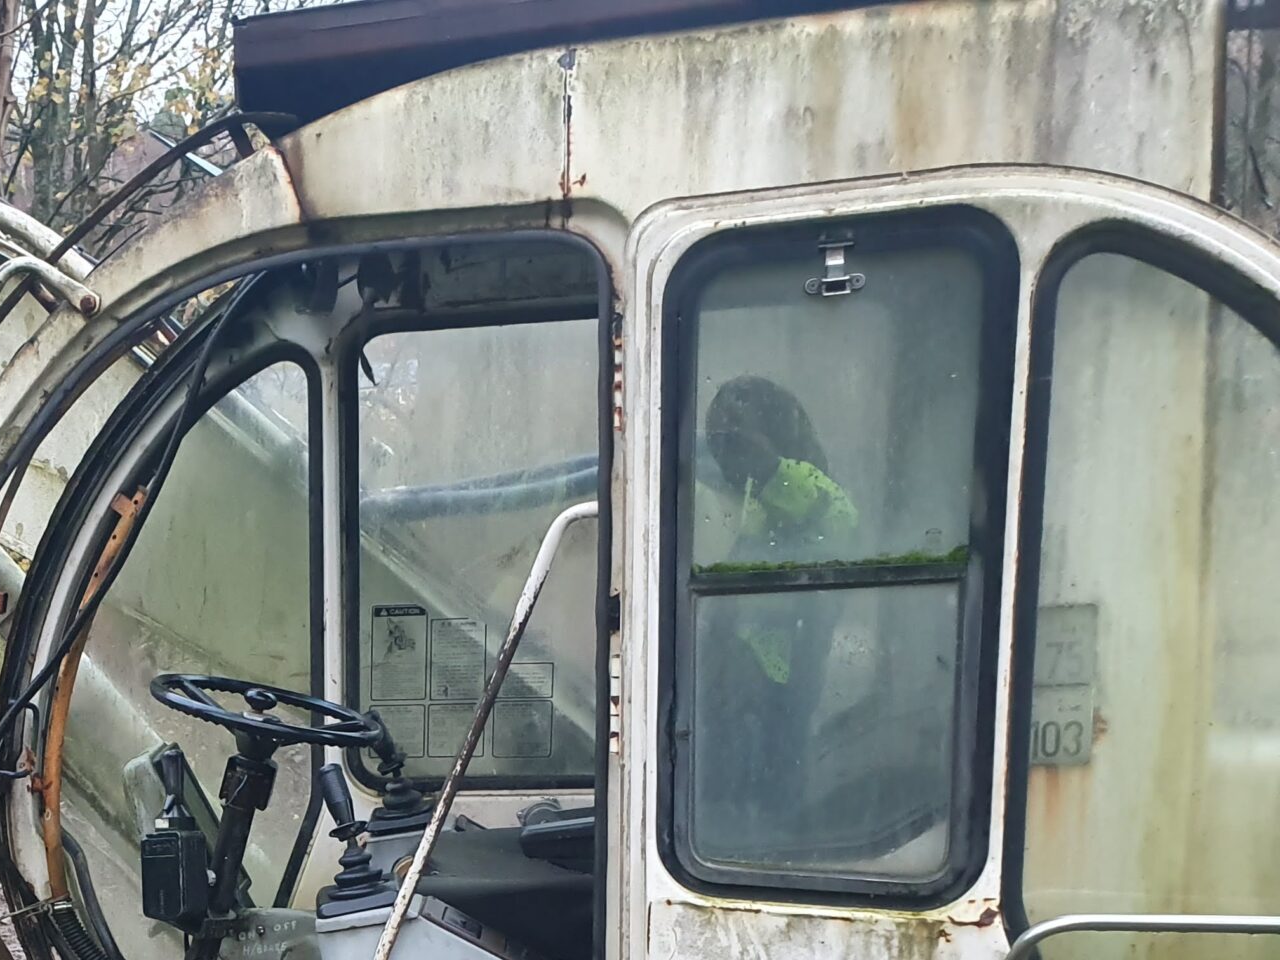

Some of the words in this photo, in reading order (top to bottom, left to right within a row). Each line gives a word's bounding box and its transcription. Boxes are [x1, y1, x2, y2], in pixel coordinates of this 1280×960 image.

[1046, 640, 1083, 679] 75
[1032, 720, 1084, 760] 103
[238, 929, 256, 940] ON
[273, 920, 297, 932] OFF
